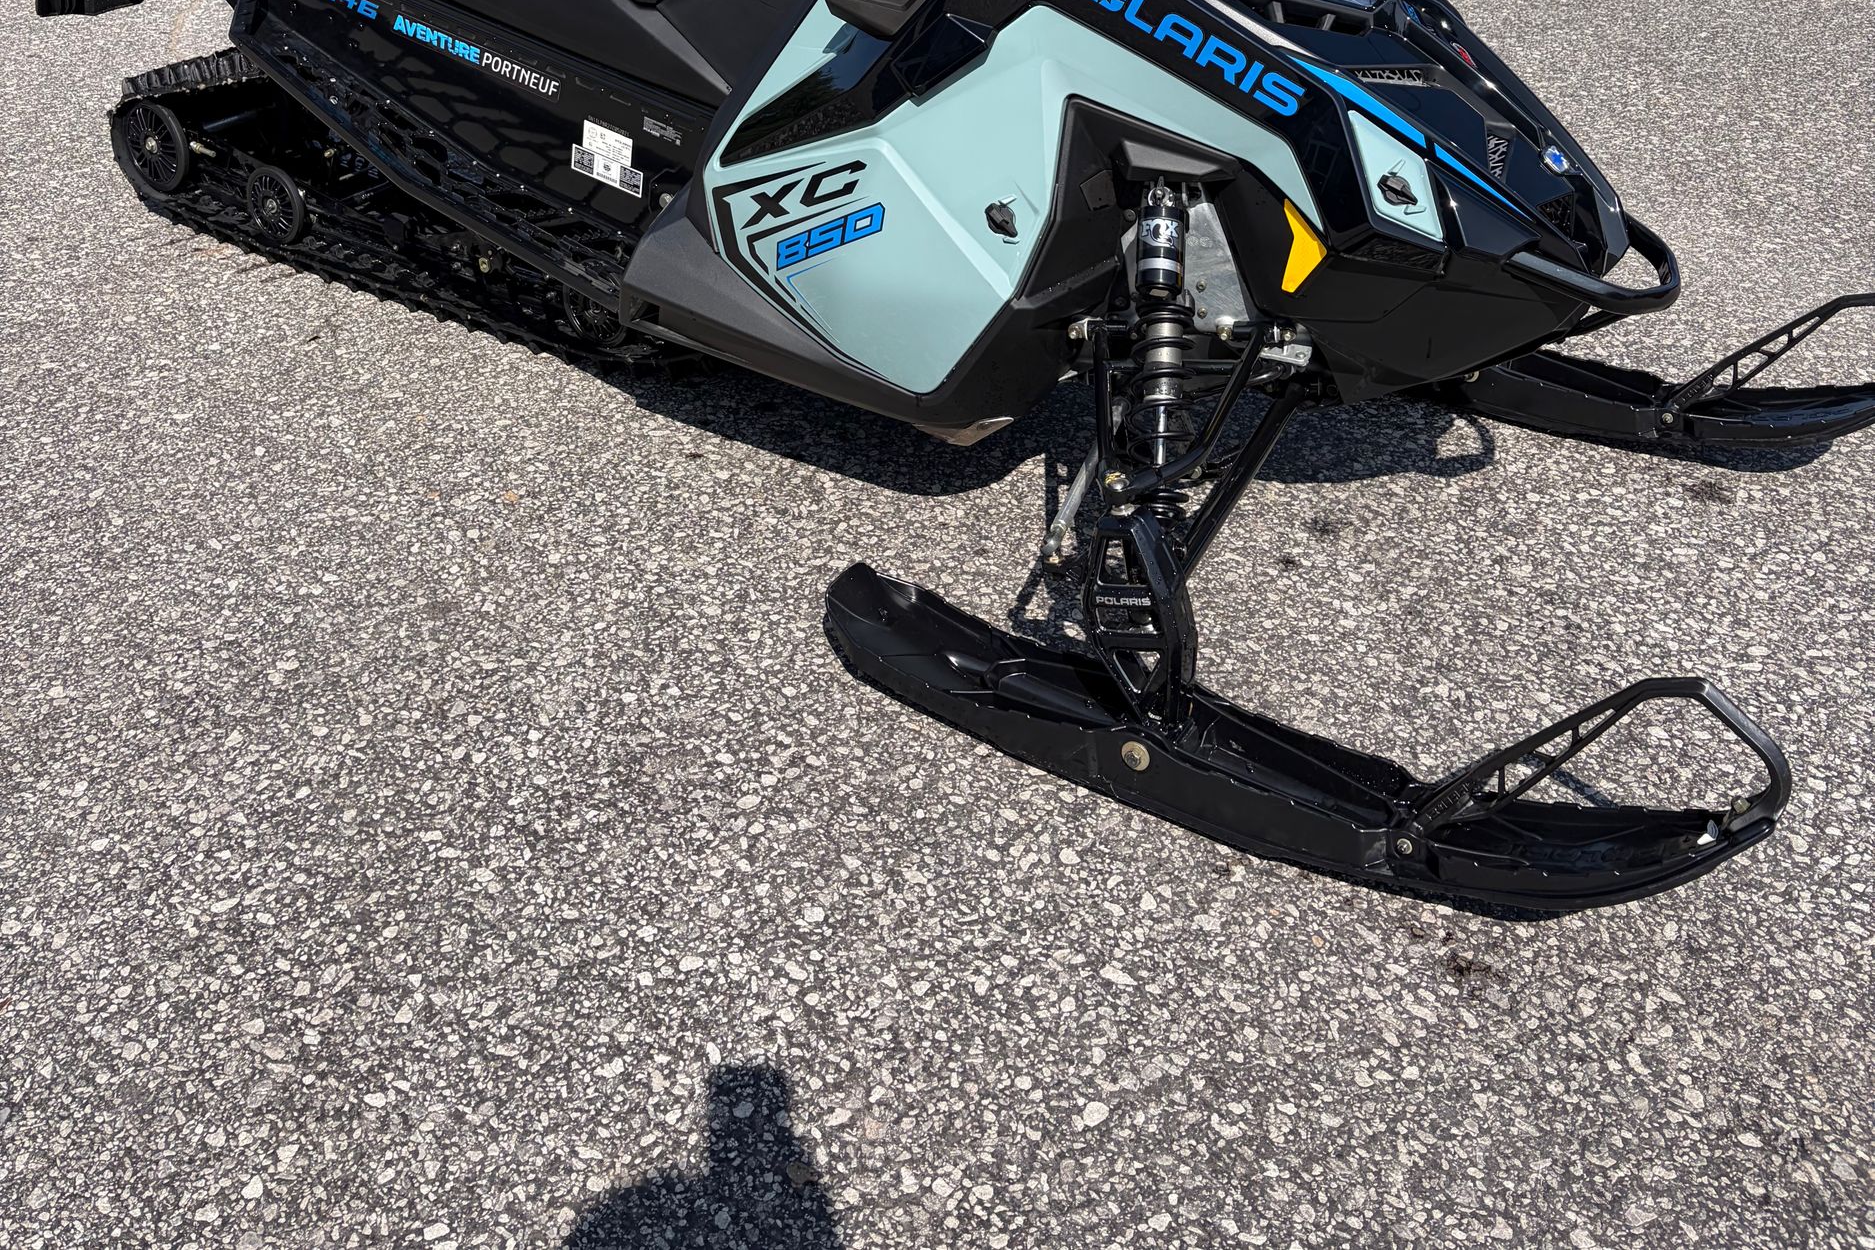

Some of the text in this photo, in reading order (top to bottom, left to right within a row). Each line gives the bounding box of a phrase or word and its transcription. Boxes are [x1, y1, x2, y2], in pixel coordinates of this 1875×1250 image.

[393, 14, 560, 98] AVENTURE PORTNEUF
[740, 159, 867, 230] XC
[776, 202, 886, 271] 850
[1141, 218, 1179, 244] FOX
[1095, 596, 1152, 606] POLARIS
